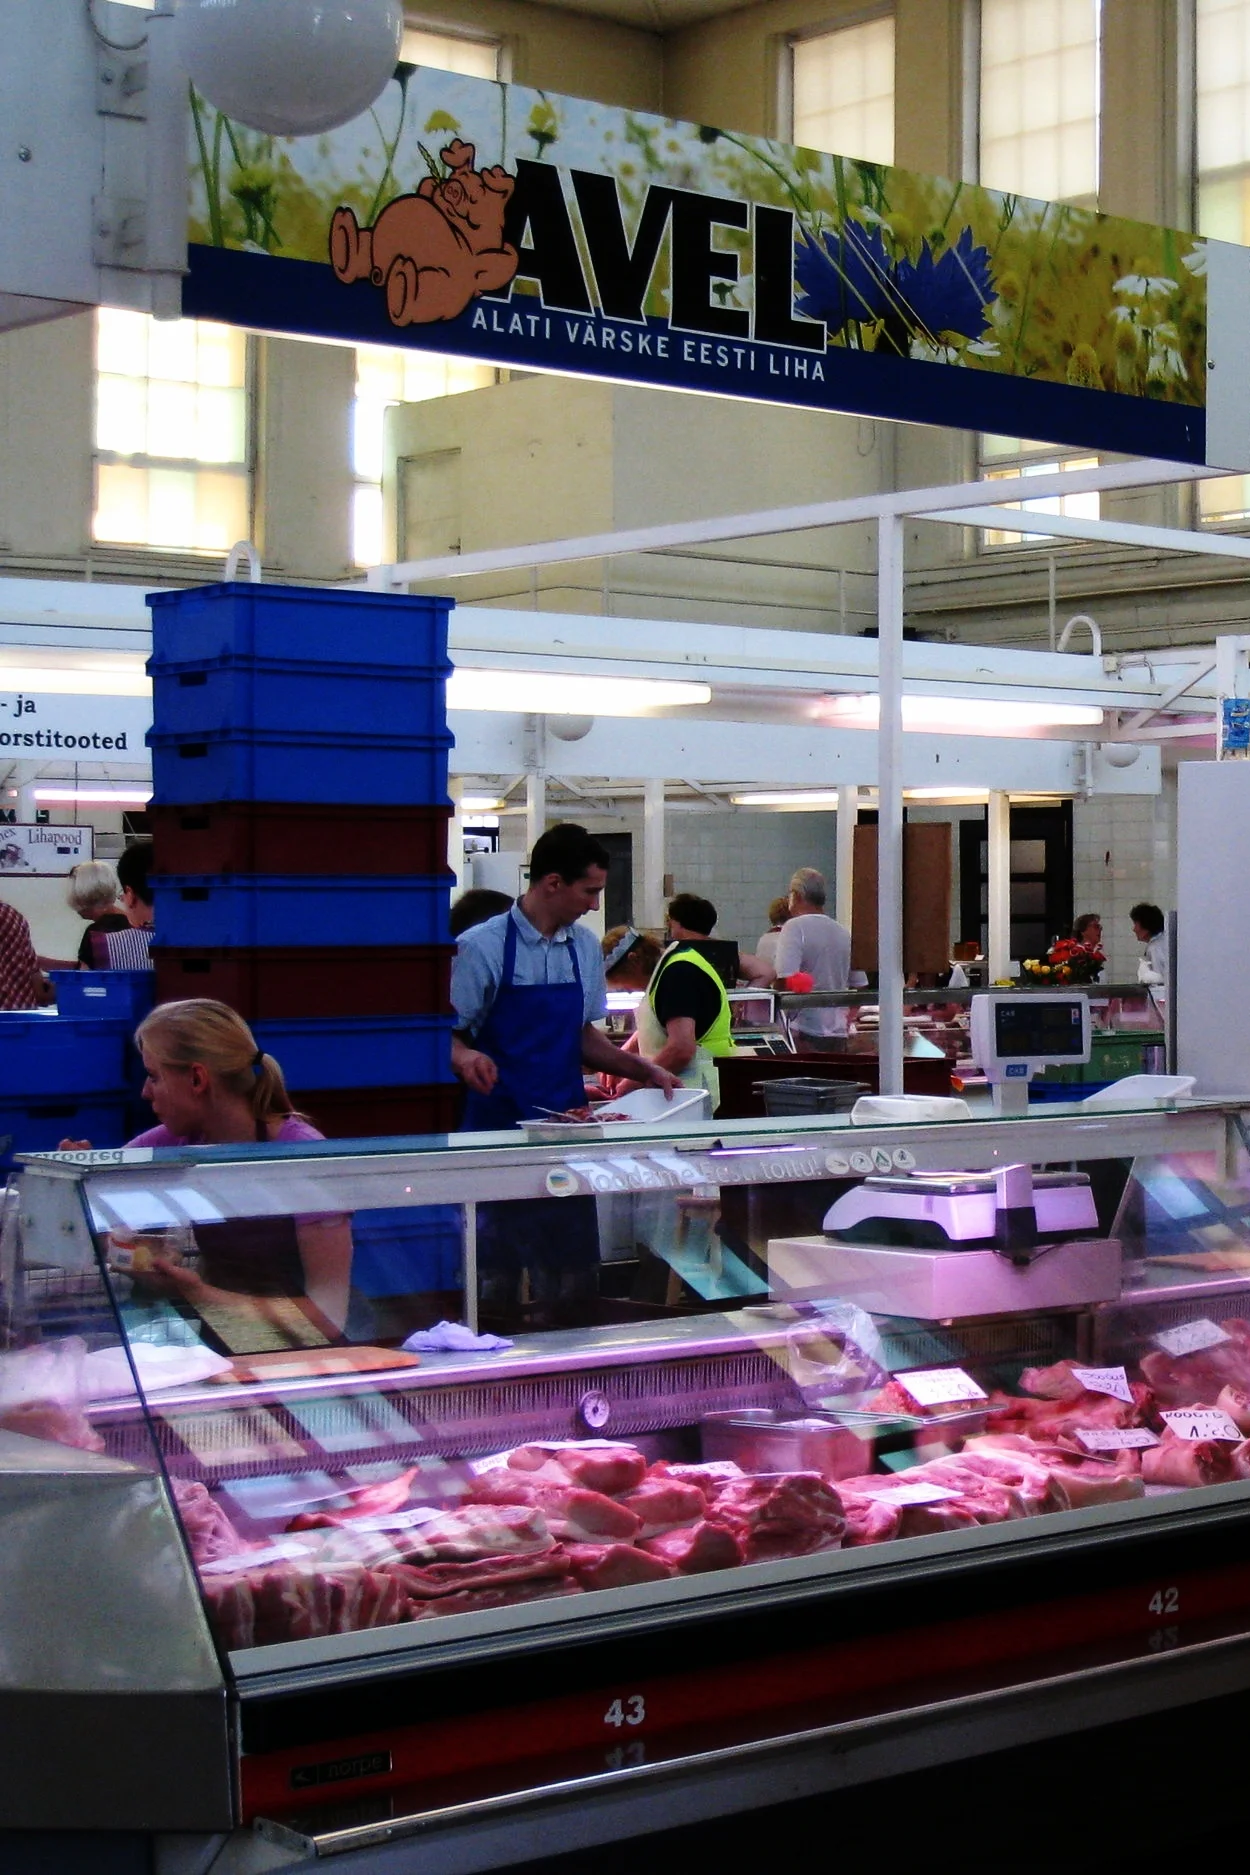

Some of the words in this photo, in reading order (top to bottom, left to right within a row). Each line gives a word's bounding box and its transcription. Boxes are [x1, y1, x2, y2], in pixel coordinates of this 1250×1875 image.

[471, 307, 551, 340] ALATI
[565, 320, 670, 358] VÄRSKE
[683, 339, 756, 372] EESTI
[768, 354, 826, 382] LIHA
[13, 694, 37, 718] ja
[28, 828, 83, 846] Lihapood
[1148, 1587, 1180, 1615] 42
[604, 1695, 646, 1727] 43
[327, 1755, 384, 1779] norpe
